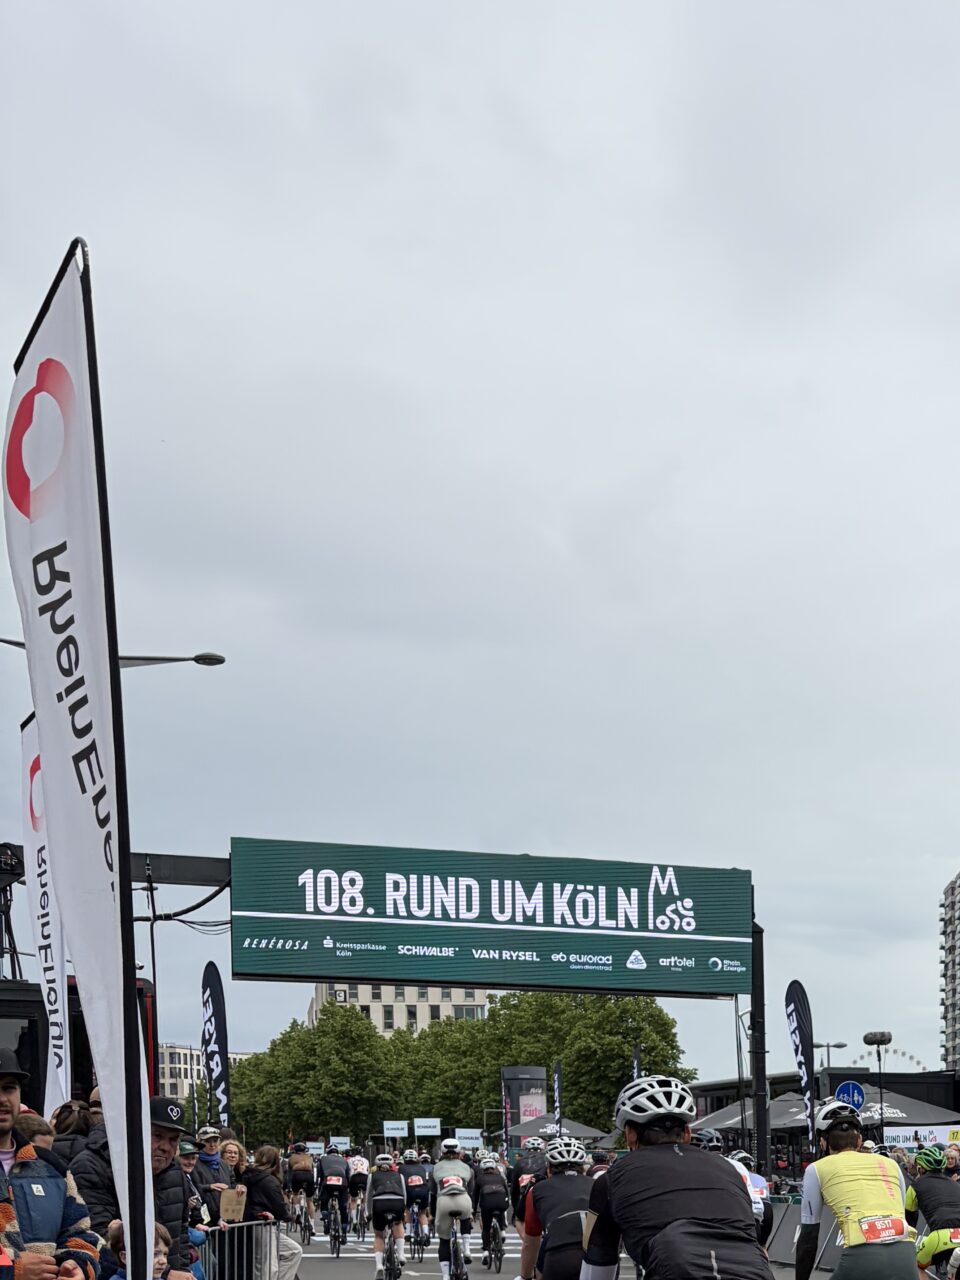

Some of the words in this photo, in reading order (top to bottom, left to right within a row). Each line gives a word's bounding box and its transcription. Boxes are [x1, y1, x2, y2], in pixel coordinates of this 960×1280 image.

[298, 868, 374, 916] 108.
[386, 872, 480, 920] RUND
[491, 879, 543, 924] UM
[553, 882, 639, 930] KÖLN
[243, 936, 309, 950] RENÉROSA
[336, 941, 387, 951] Kreissparkasse
[398, 945, 456, 957] SCHWALBE
[472, 949, 499, 960] VAN
[502, 950, 541, 962] RYSEL
[569, 954, 613, 964] eurorad
[723, 965, 747, 973] Energie
[885, 1135, 900, 1144] RUND
[902, 1135, 911, 1143] UM
